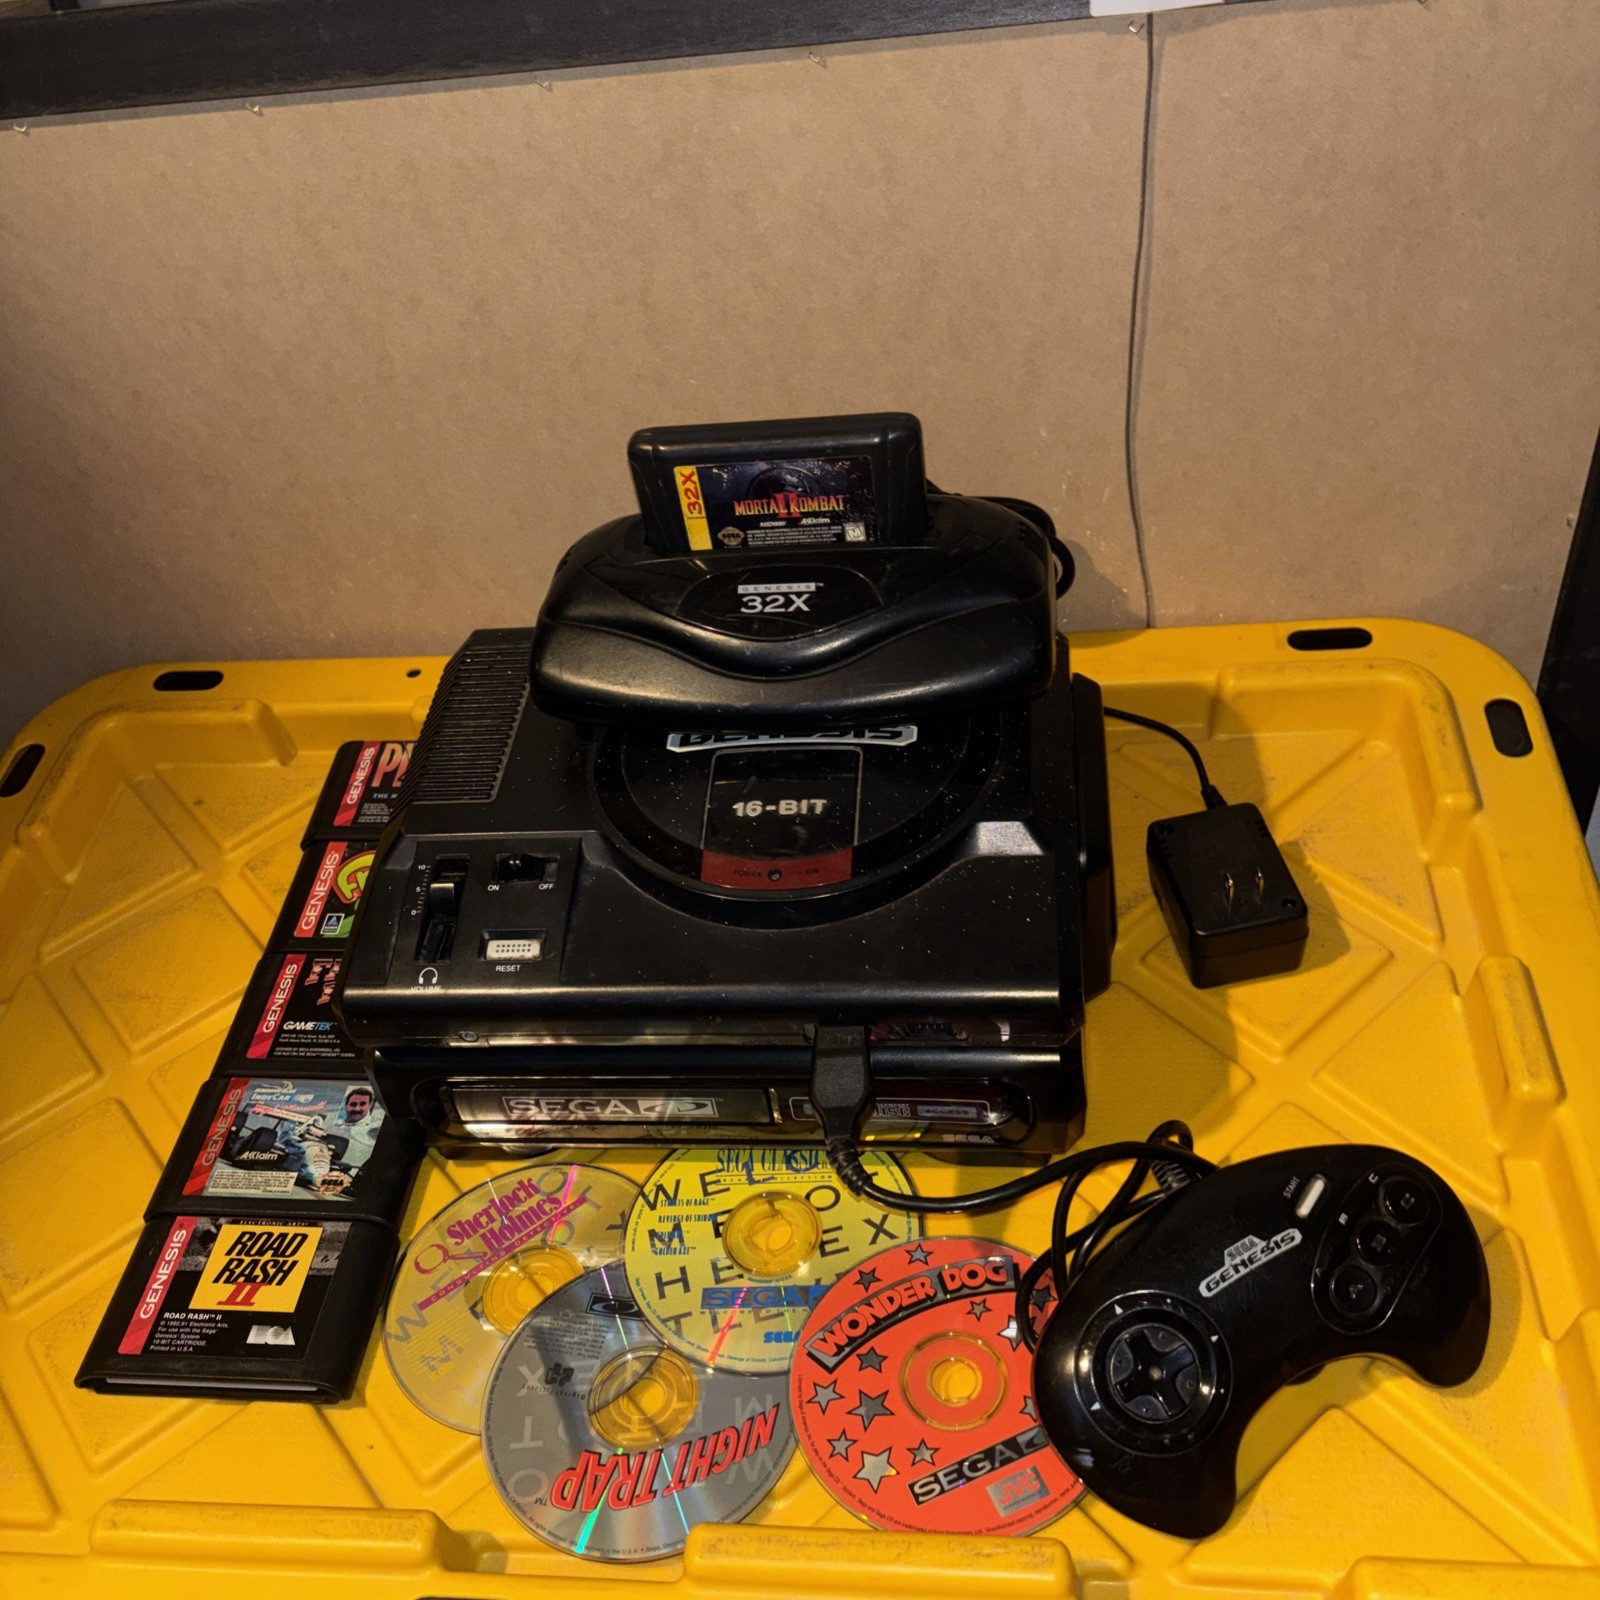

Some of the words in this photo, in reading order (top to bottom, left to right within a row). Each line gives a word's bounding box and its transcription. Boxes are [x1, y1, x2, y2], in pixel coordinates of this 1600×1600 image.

[681, 470, 702, 515] 32X
[733, 498, 788, 516] MORTAL
[789, 494, 846, 514] KOMBAT
[740, 593, 812, 614] 32X
[346, 747, 376, 805] GENESIS
[732, 799, 828, 818] 16-BIT
[732, 868, 765, 879] POWER
[301, 851, 340, 931] GENESIS
[487, 883, 500, 891] ON
[495, 964, 521, 972] RESET
[262, 962, 299, 1034] GENESIS
[282, 1020, 334, 1032] GAMETEK
[509, 1099, 635, 1115] SEGA
[201, 1088, 243, 1168] GENESIS
[941, 1134, 996, 1144] SEGA
[320, 1178, 345, 1187] SEGA
[1282, 1175, 1300, 1199] START
[446, 1177, 542, 1247] Sherlock
[478, 1191, 563, 1255] Holmes
[224, 1231, 309, 1257] ROAD
[1227, 1237, 1259, 1262] SEGA
[139, 1229, 188, 1320] GENESIS
[211, 1258, 299, 1286] RASH
[1205, 1230, 1297, 1294] GENESIS
[216, 1281, 270, 1307] II
[705, 1287, 806, 1308] SEGA
[163, 1312, 186, 1320] ROAD
[810, 1275, 937, 1357] WONDER
[940, 1260, 1008, 1292] DOG
[663, 1402, 780, 1497] NIGHT
[550, 1449, 662, 1512] TRAP
[911, 1444, 1015, 1502] SEGA
[1000, 1471, 1042, 1505] JVC
